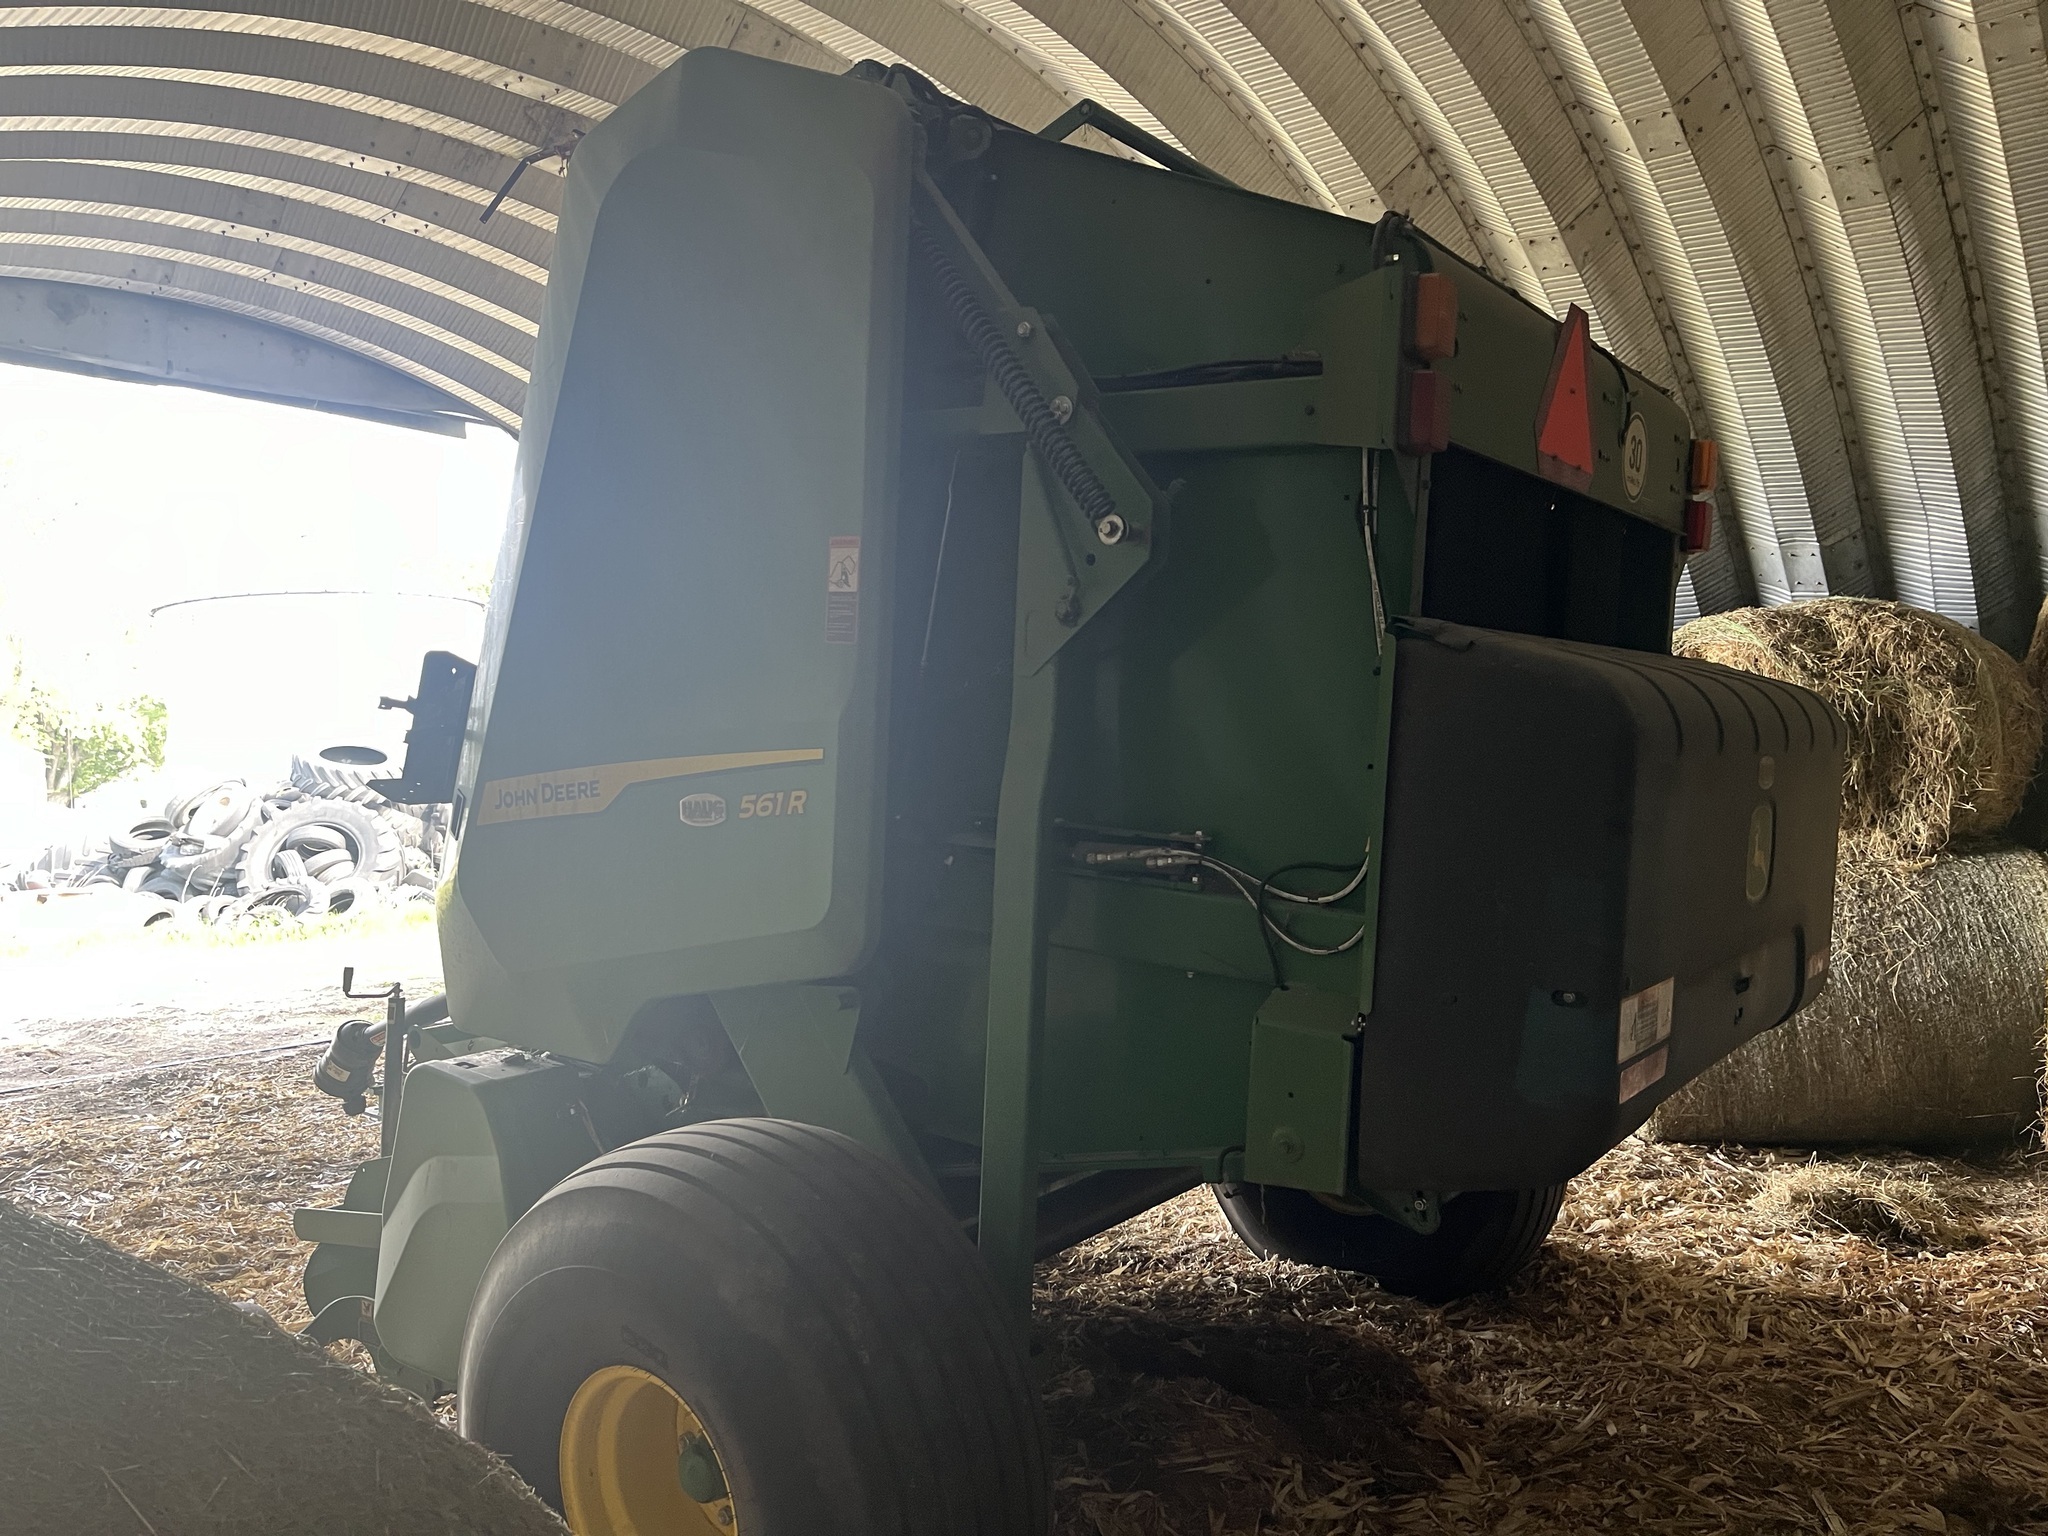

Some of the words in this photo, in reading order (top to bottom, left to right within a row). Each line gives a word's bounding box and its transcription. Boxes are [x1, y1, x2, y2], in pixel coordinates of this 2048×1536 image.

[1629, 435, 1643, 473] 30
[494, 787, 538, 810] JOHN
[541, 780, 601, 804] DEERE
